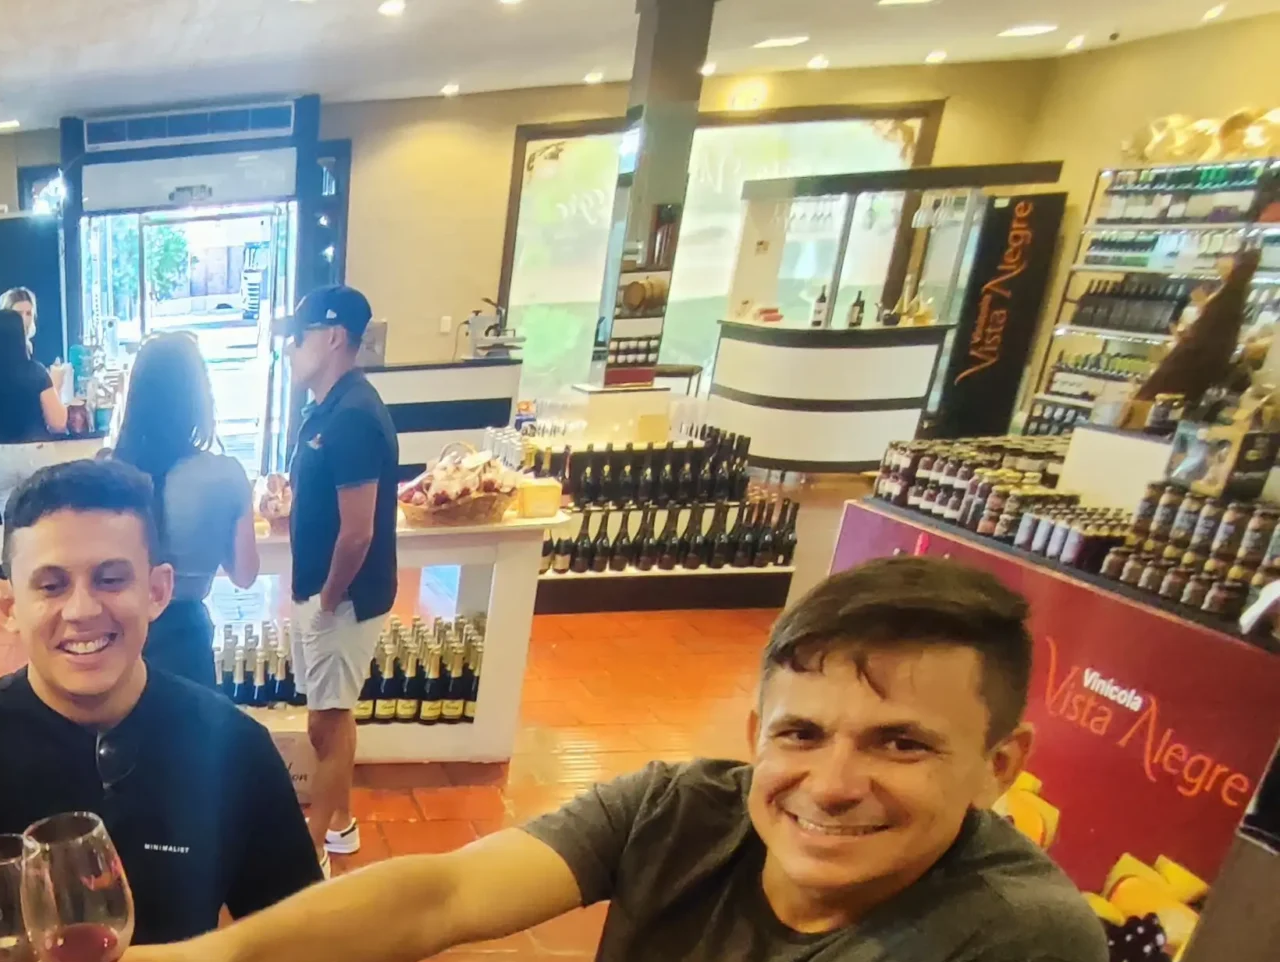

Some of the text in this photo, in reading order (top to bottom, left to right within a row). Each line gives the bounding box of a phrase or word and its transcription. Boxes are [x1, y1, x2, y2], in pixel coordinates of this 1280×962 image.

[955, 200, 1034, 386] Vista Alegre
[1045, 635, 1250, 806] Vista Alegre
[144, 843, 190, 853] MINIMALIST
